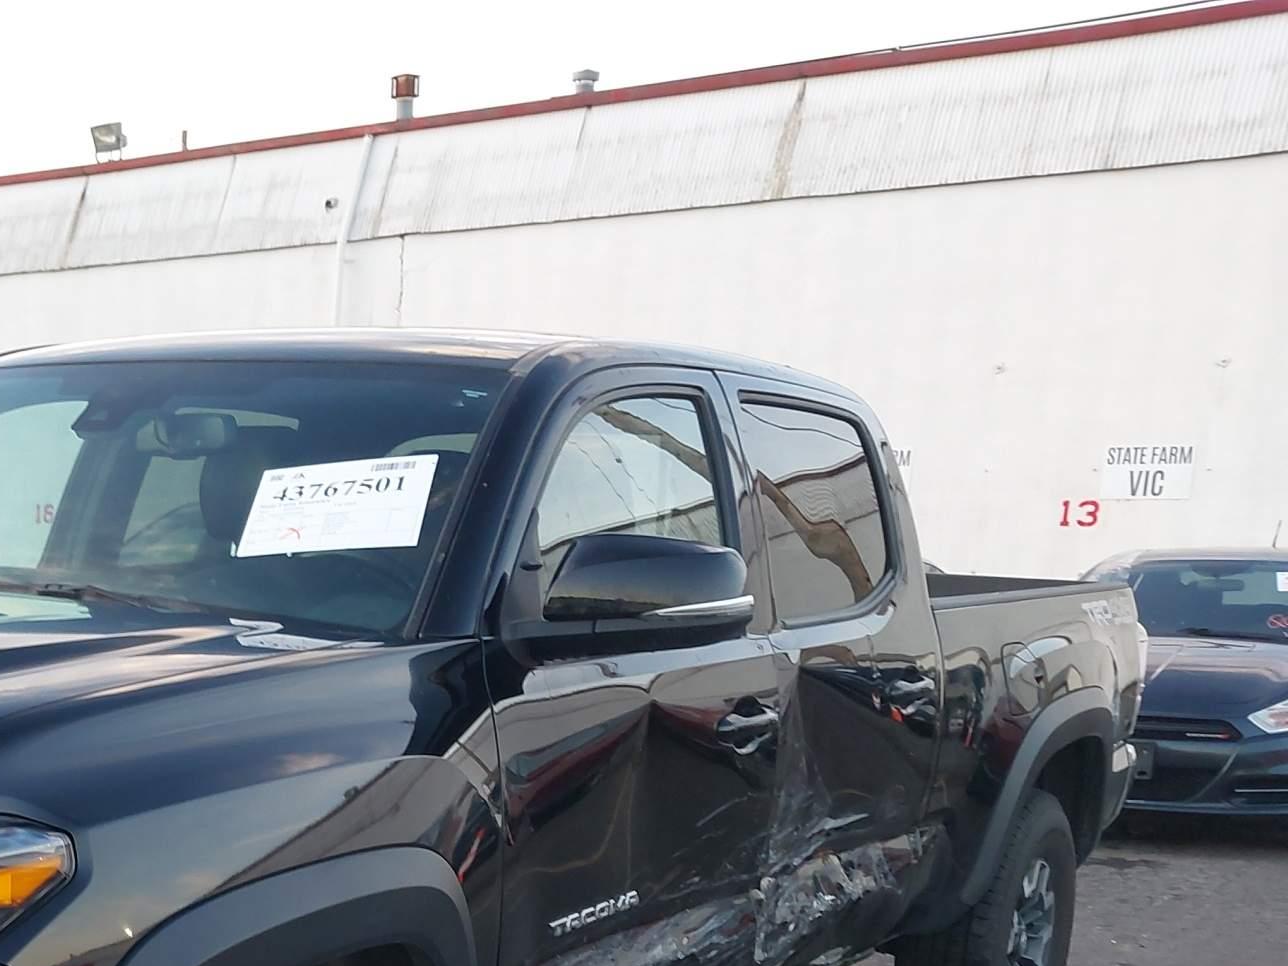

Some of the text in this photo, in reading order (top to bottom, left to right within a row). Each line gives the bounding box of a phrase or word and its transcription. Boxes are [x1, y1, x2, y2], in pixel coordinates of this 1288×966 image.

[1106, 445, 1194, 465] STATE FARM
[272, 475, 406, 502] 43767501
[1128, 469, 1165, 497] VIC
[1059, 499, 1100, 527] 13
[548, 889, 641, 937] TACOMA
